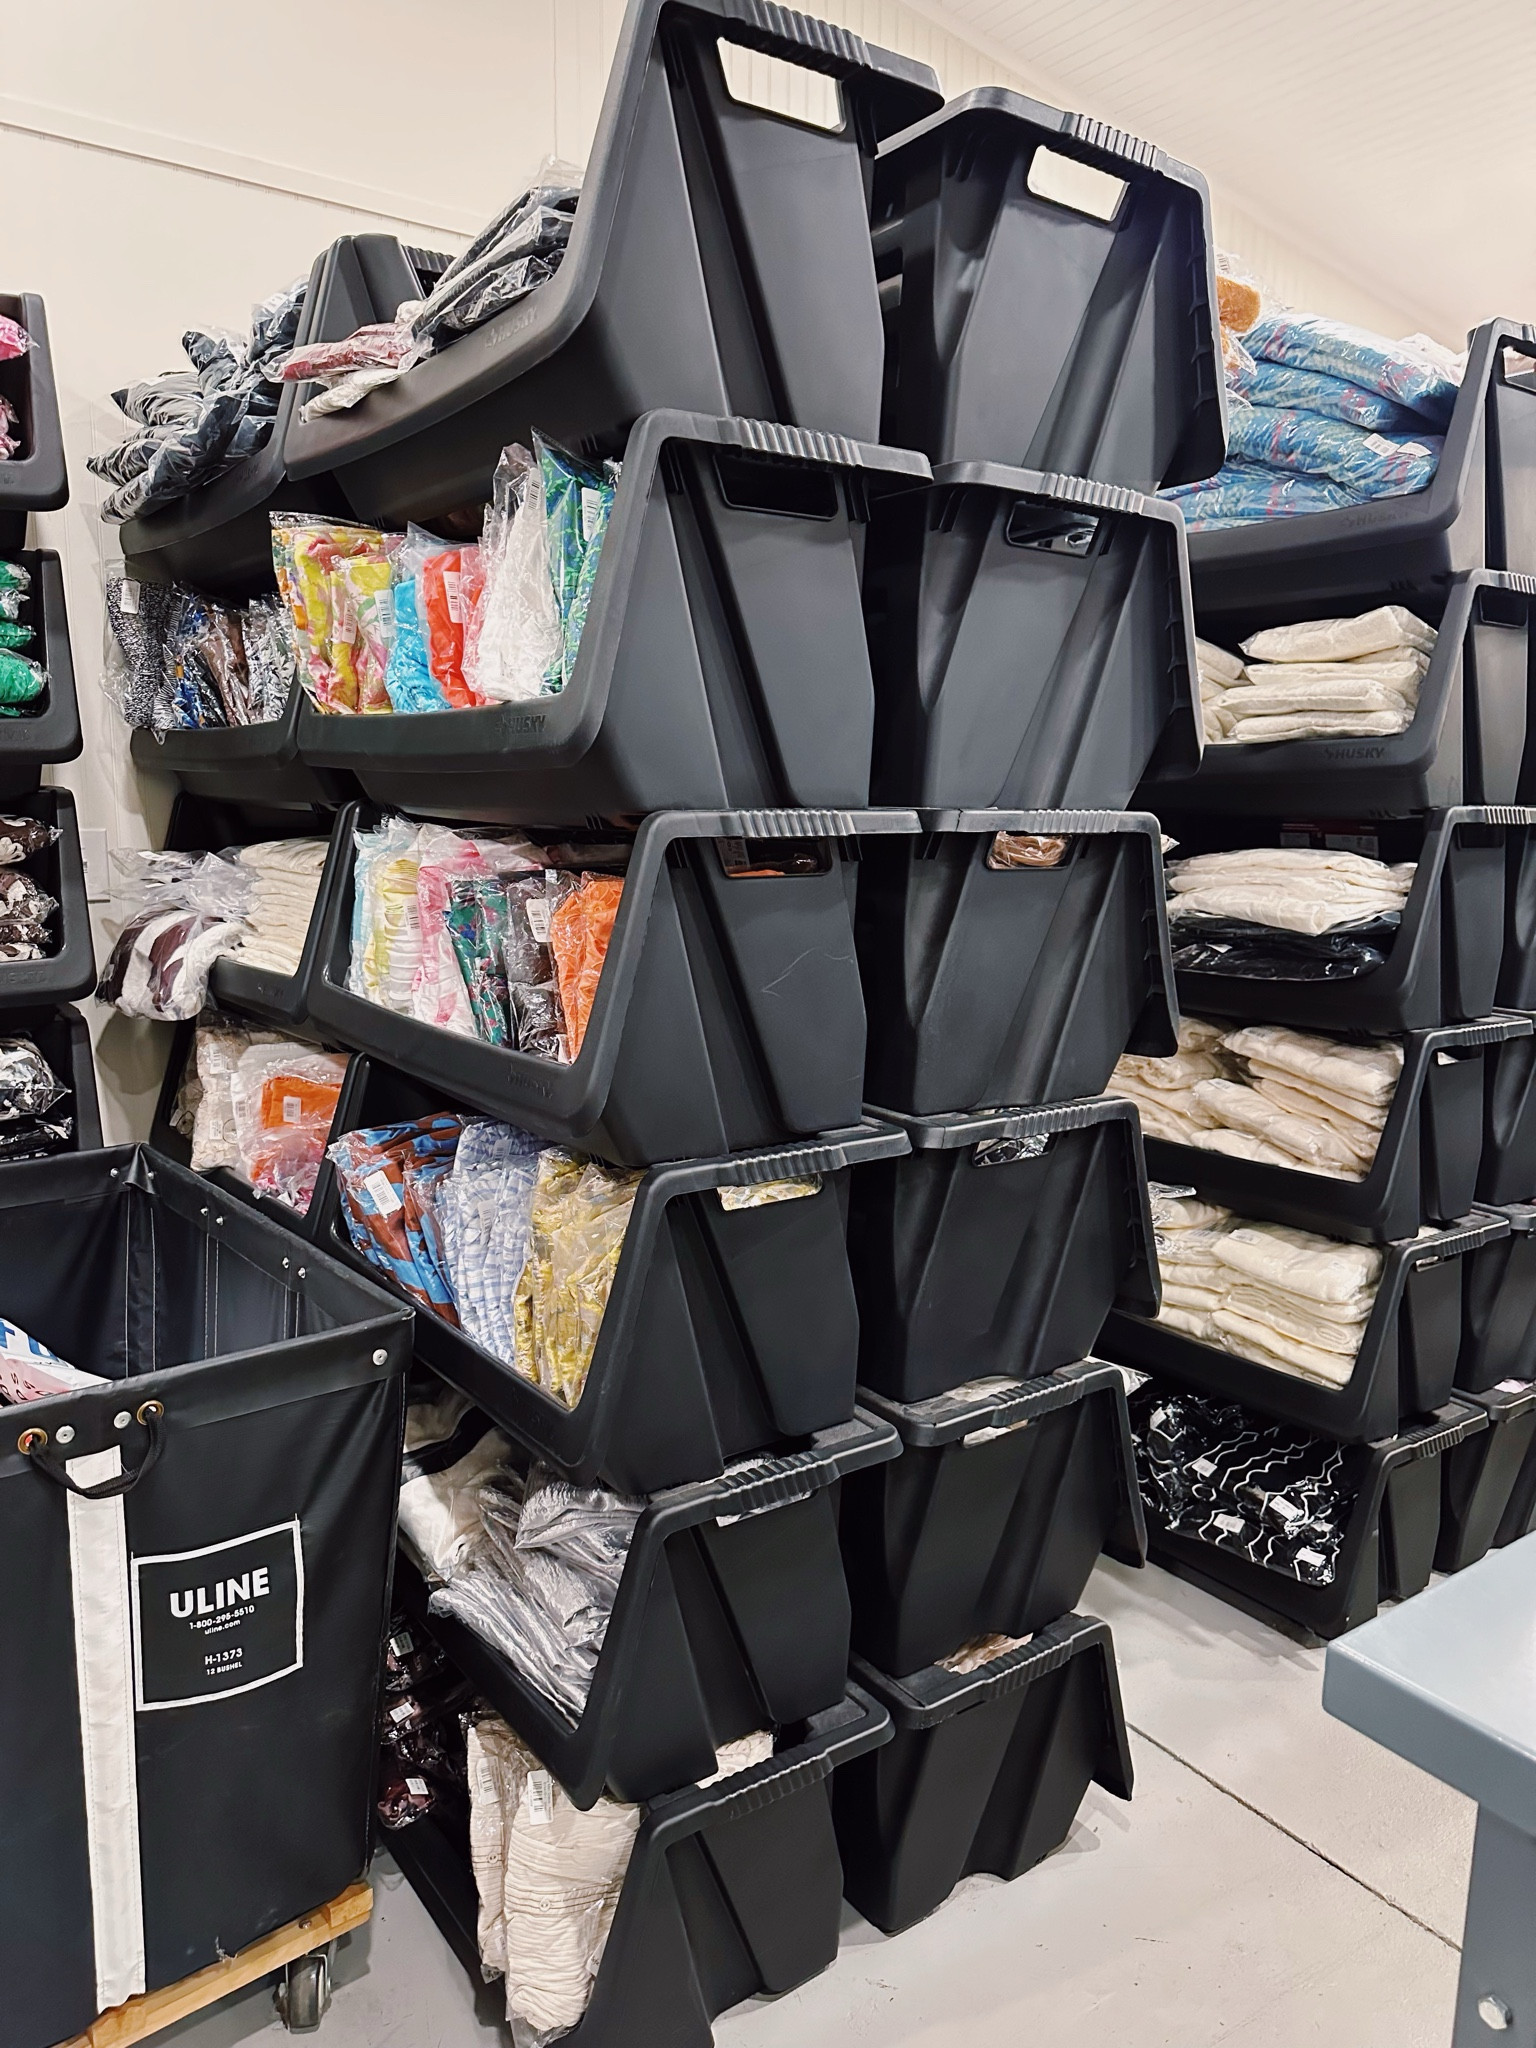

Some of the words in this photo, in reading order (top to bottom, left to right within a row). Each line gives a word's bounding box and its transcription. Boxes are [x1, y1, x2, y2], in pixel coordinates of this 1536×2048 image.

[1335, 747, 1385, 759] HUSKY
[169, 1566, 270, 1618] ULINE
[189, 1604, 255, 1630] 1-800-295-5510
[204, 1619, 241, 1635] uline.com
[204, 1647, 243, 1666] H-1373
[206, 1668, 216, 1676] 12
[217, 1661, 243, 1674] BUSHEL
